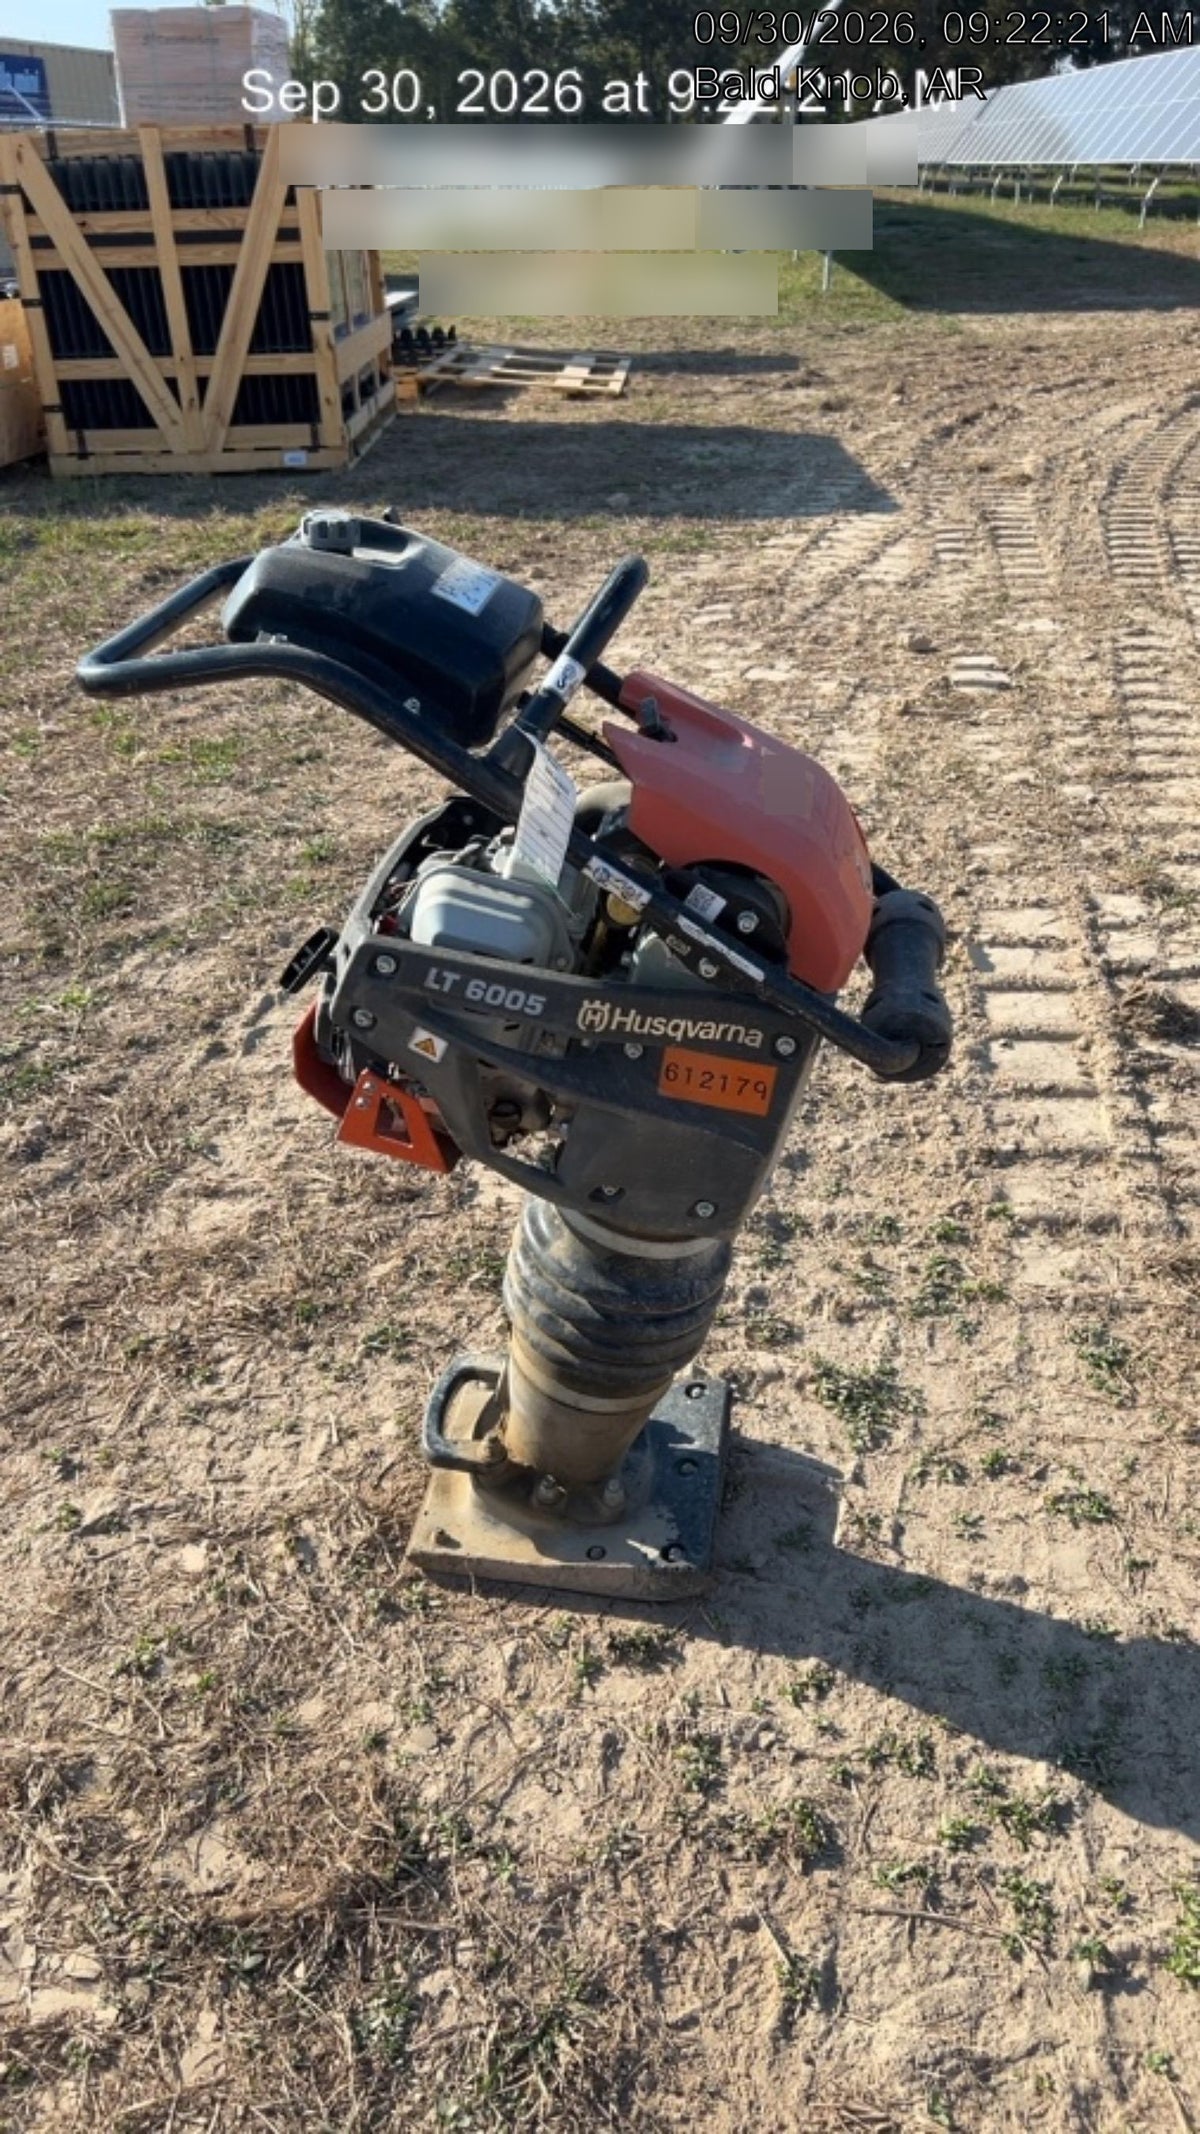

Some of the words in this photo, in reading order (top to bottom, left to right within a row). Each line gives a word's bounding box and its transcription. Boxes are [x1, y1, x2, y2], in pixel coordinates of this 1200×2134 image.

[424, 967, 461, 992] LT
[465, 978, 547, 1017] 6005
[611, 1005, 764, 1048] Husqvarna
[664, 1061, 768, 1100] 612179
